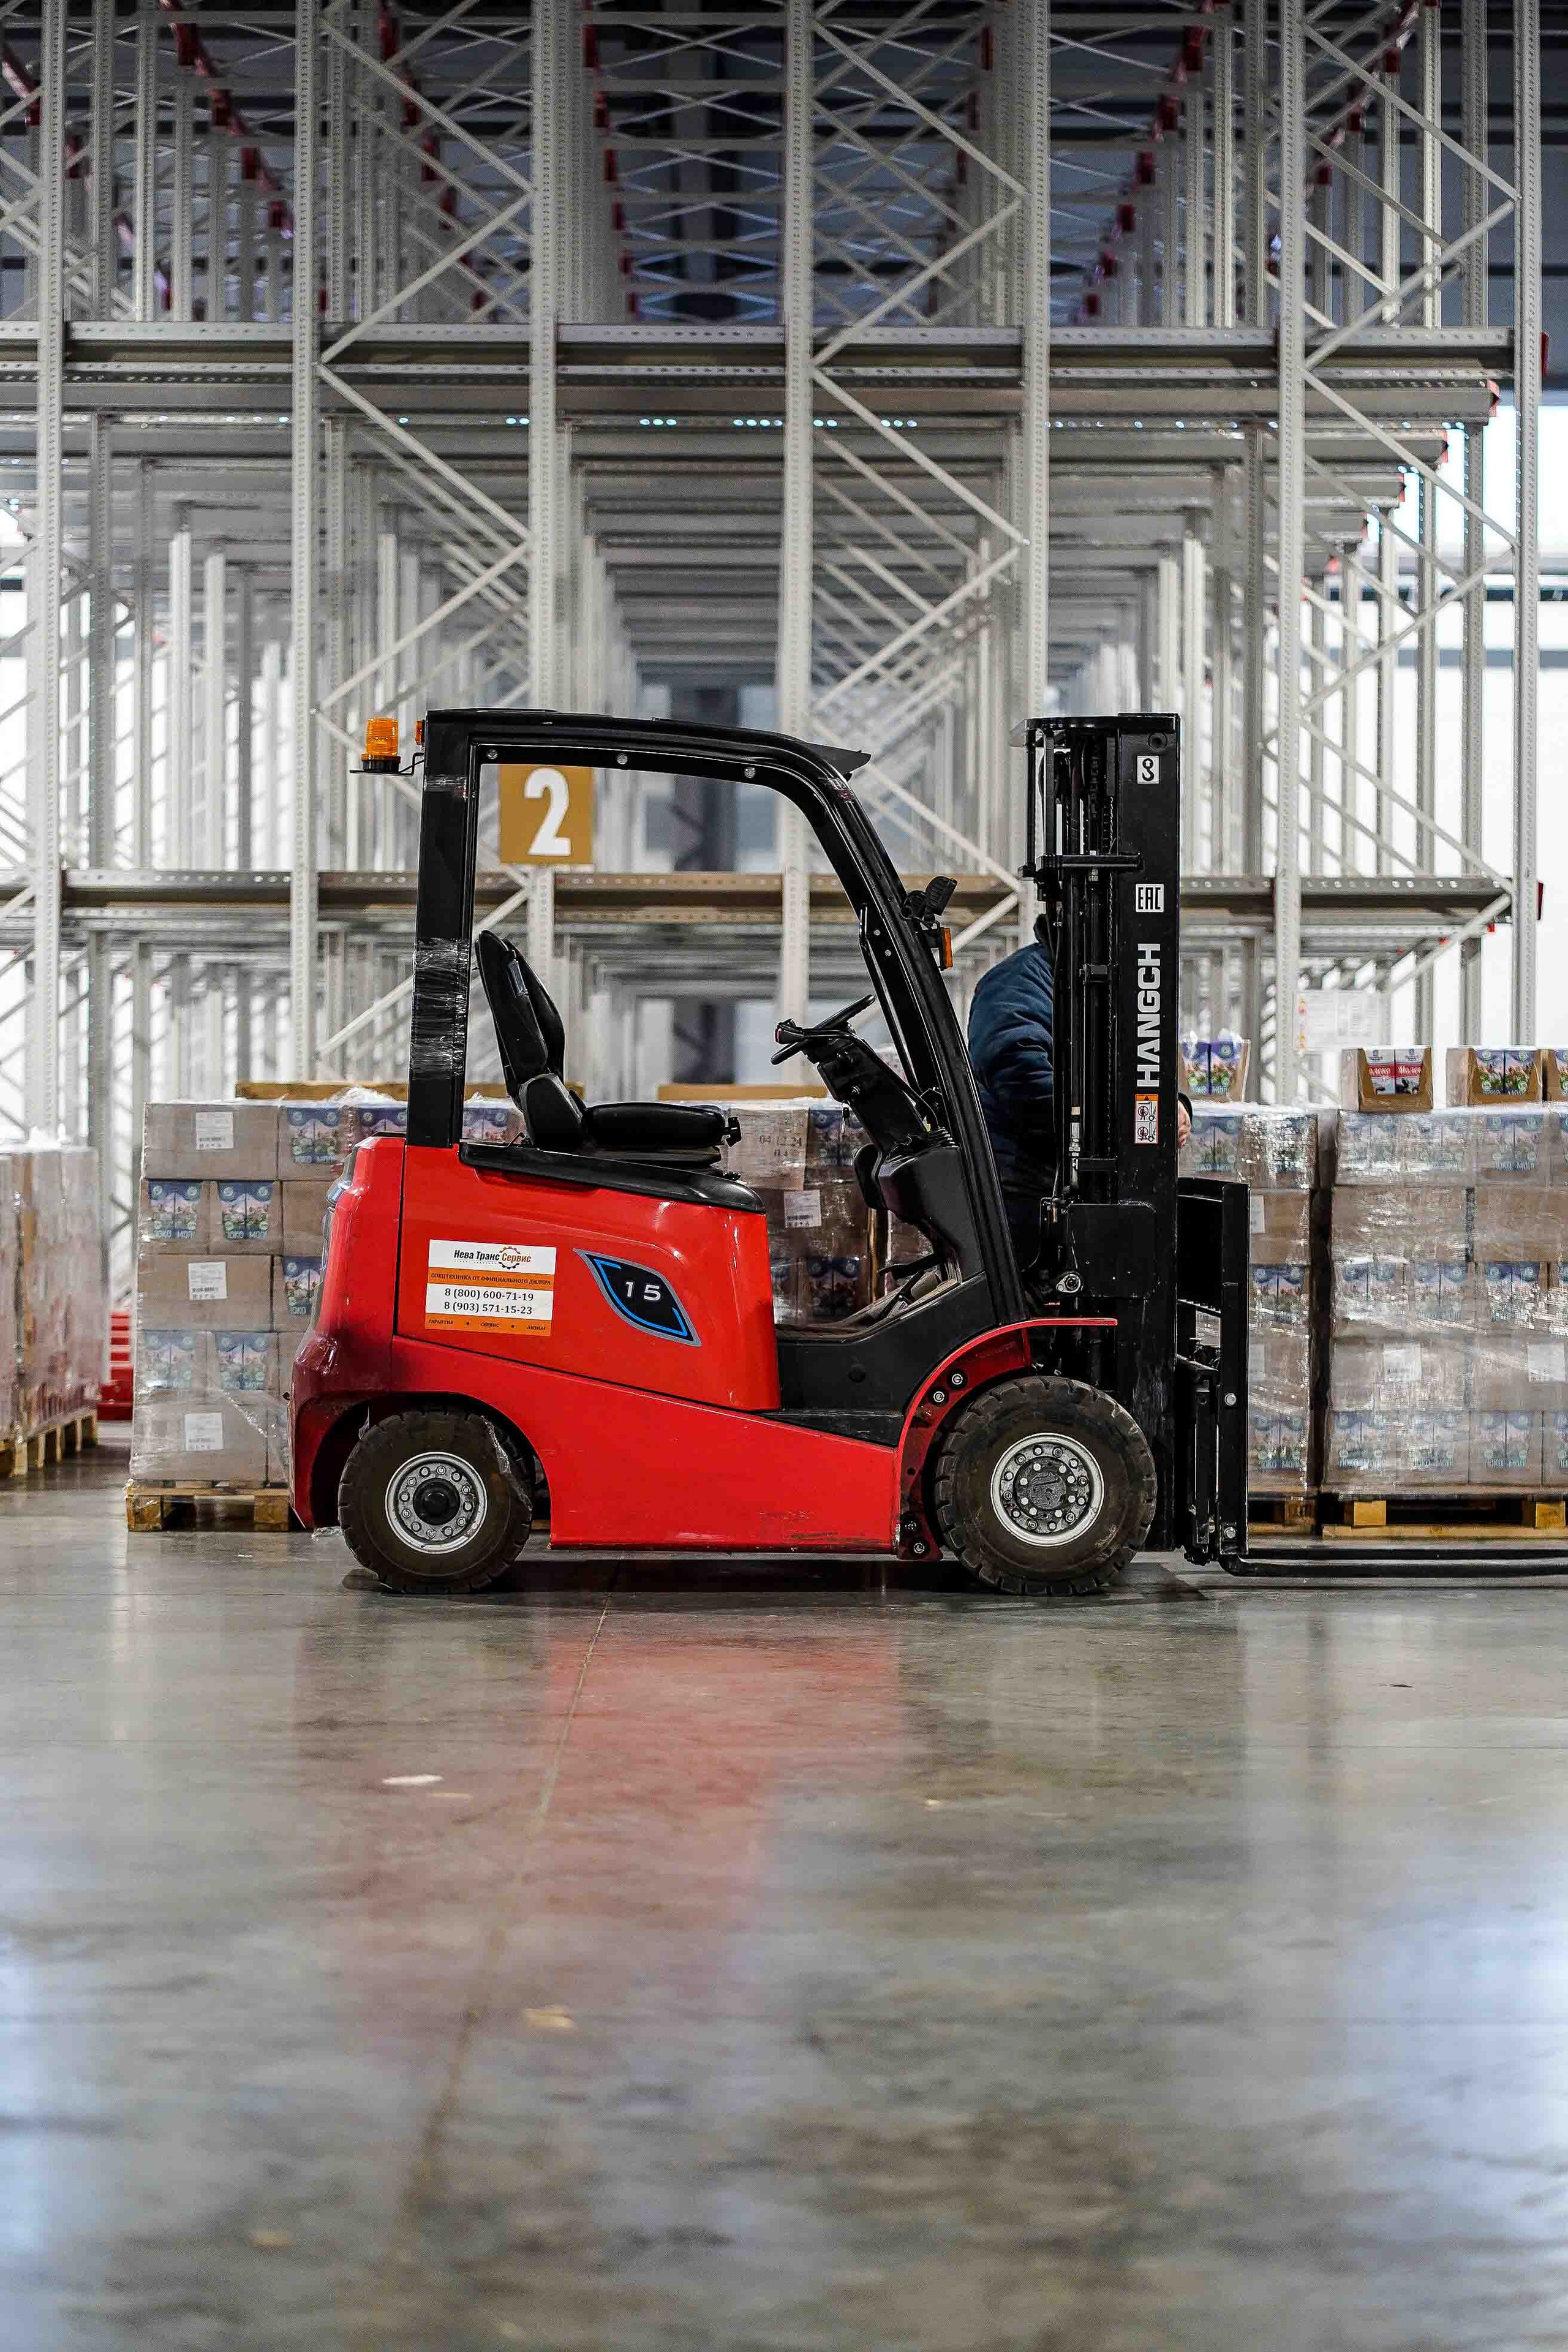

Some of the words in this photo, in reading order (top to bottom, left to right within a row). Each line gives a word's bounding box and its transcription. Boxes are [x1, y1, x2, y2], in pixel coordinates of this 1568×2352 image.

[525, 767, 572, 856] 2
[1138, 887, 1161, 910] EAC
[1137, 943, 1161, 1087] HANGCH
[454, 1250, 473, 1259] Нева
[476, 1251, 500, 1261] Транс
[502, 1253, 532, 1264] Сервис
[453, 1288, 480, 1300] (800)
[483, 1291, 533, 1301] 600-71-19
[453, 1302, 480, 1313] (903)
[482, 1304, 532, 1314] 571-15-23
